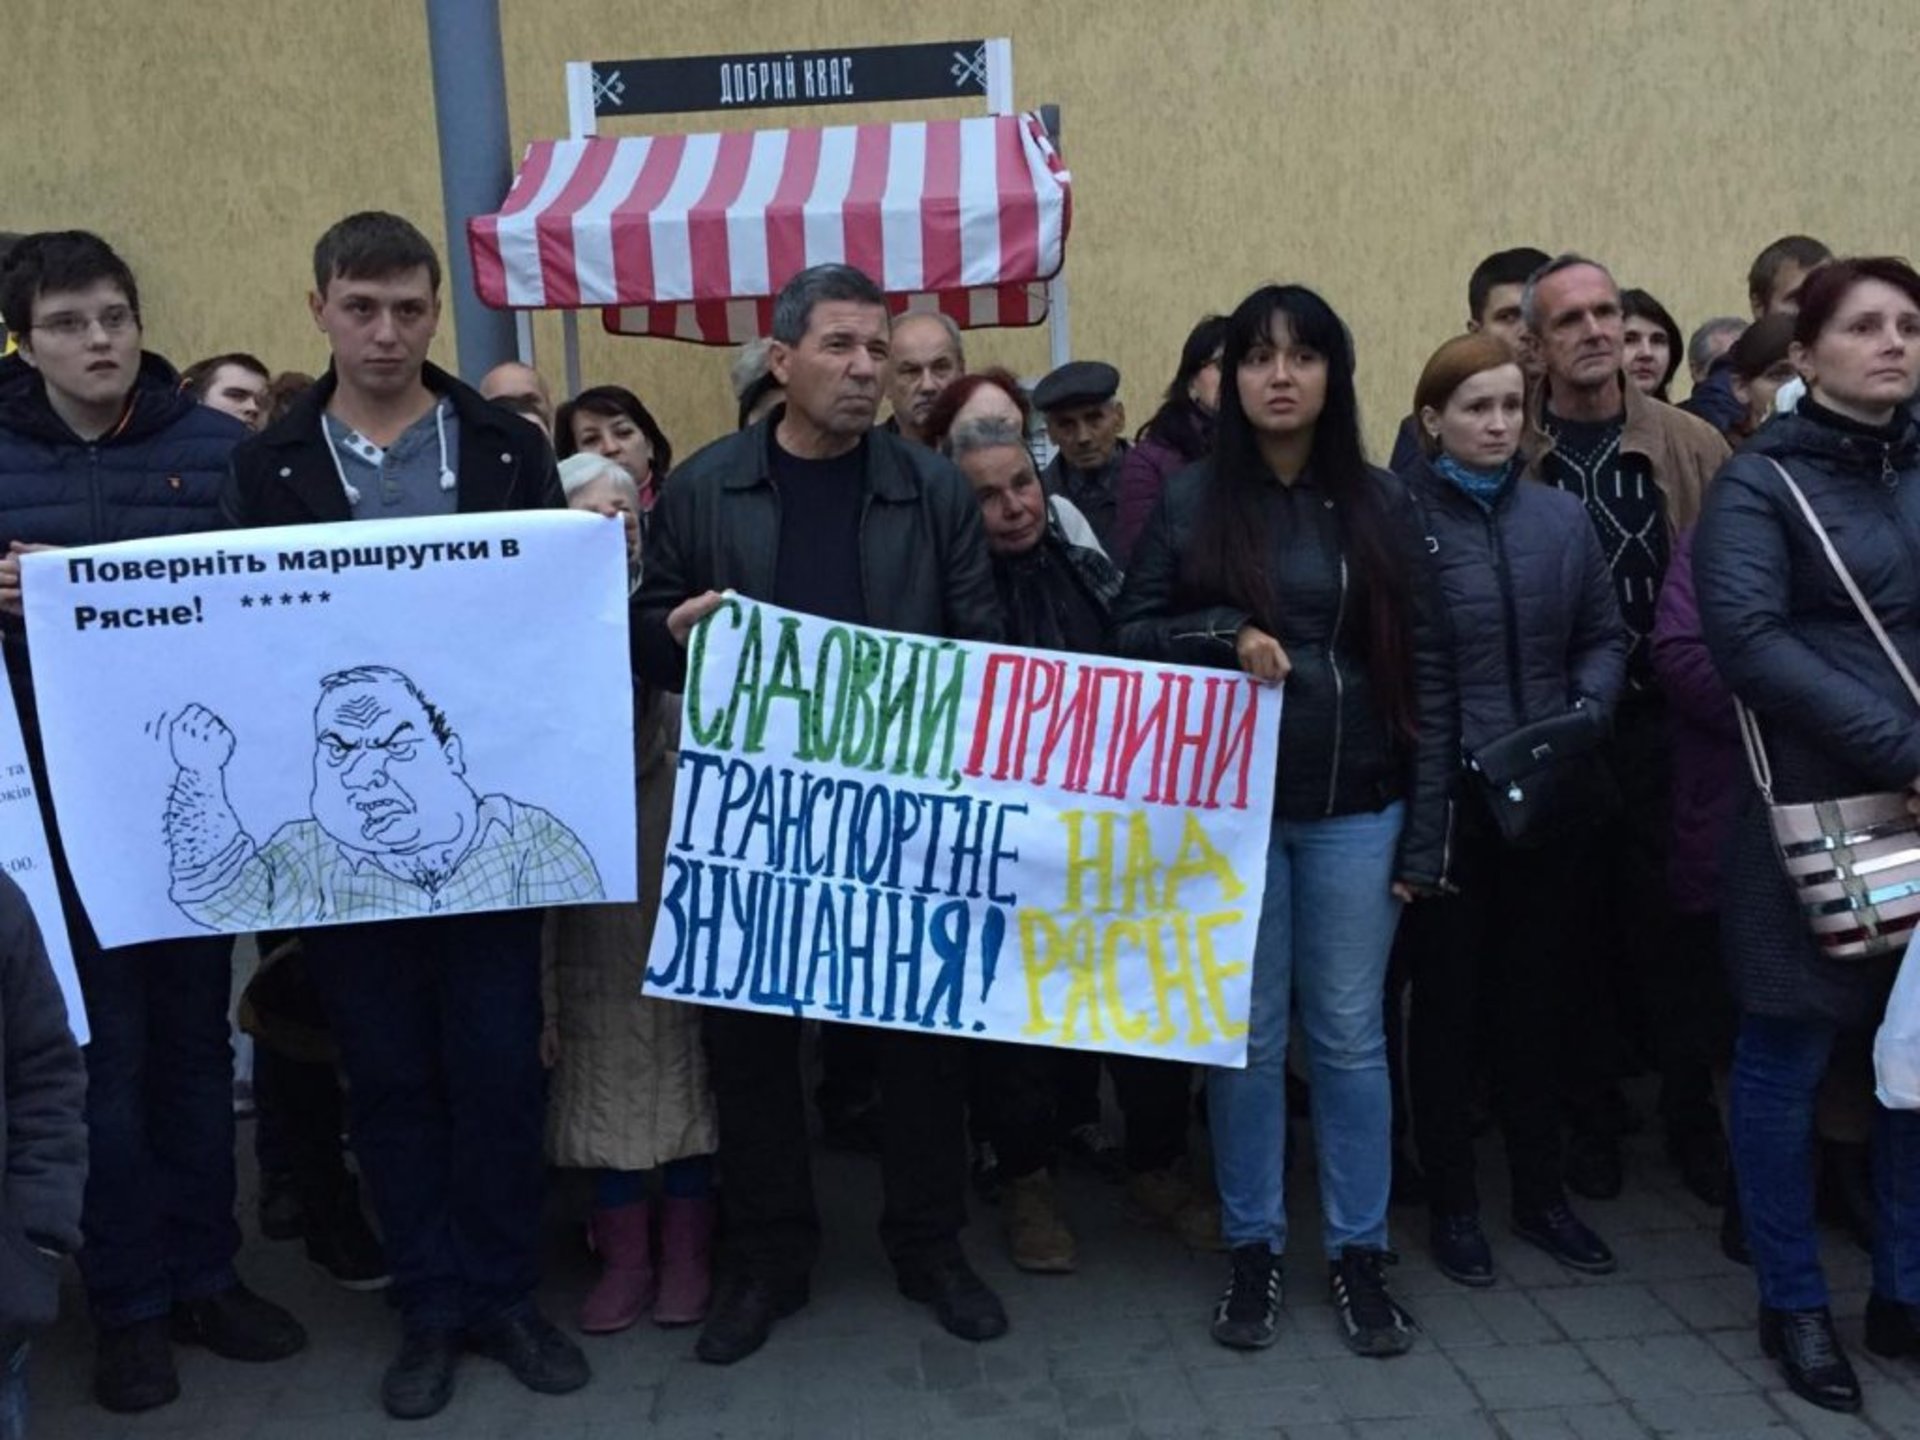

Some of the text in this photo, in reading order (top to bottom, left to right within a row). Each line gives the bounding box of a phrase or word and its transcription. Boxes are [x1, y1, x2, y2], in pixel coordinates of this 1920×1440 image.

[720, 54, 854, 104] ДОБРИЙ КВАС
[67, 538, 520, 584] Поверніть маршрутки в
[74, 596, 204, 631] Рясне!
[687, 597, 1261, 809] САДОВИЙ, ПРИПИНИ
[678, 749, 1029, 906] ТРАНСПОРТНЕ
[1058, 810, 1246, 914] НАД
[646, 851, 1006, 1032] ЗНУЩАННЯ!
[1018, 907, 1252, 1046] РЯСНЕ
